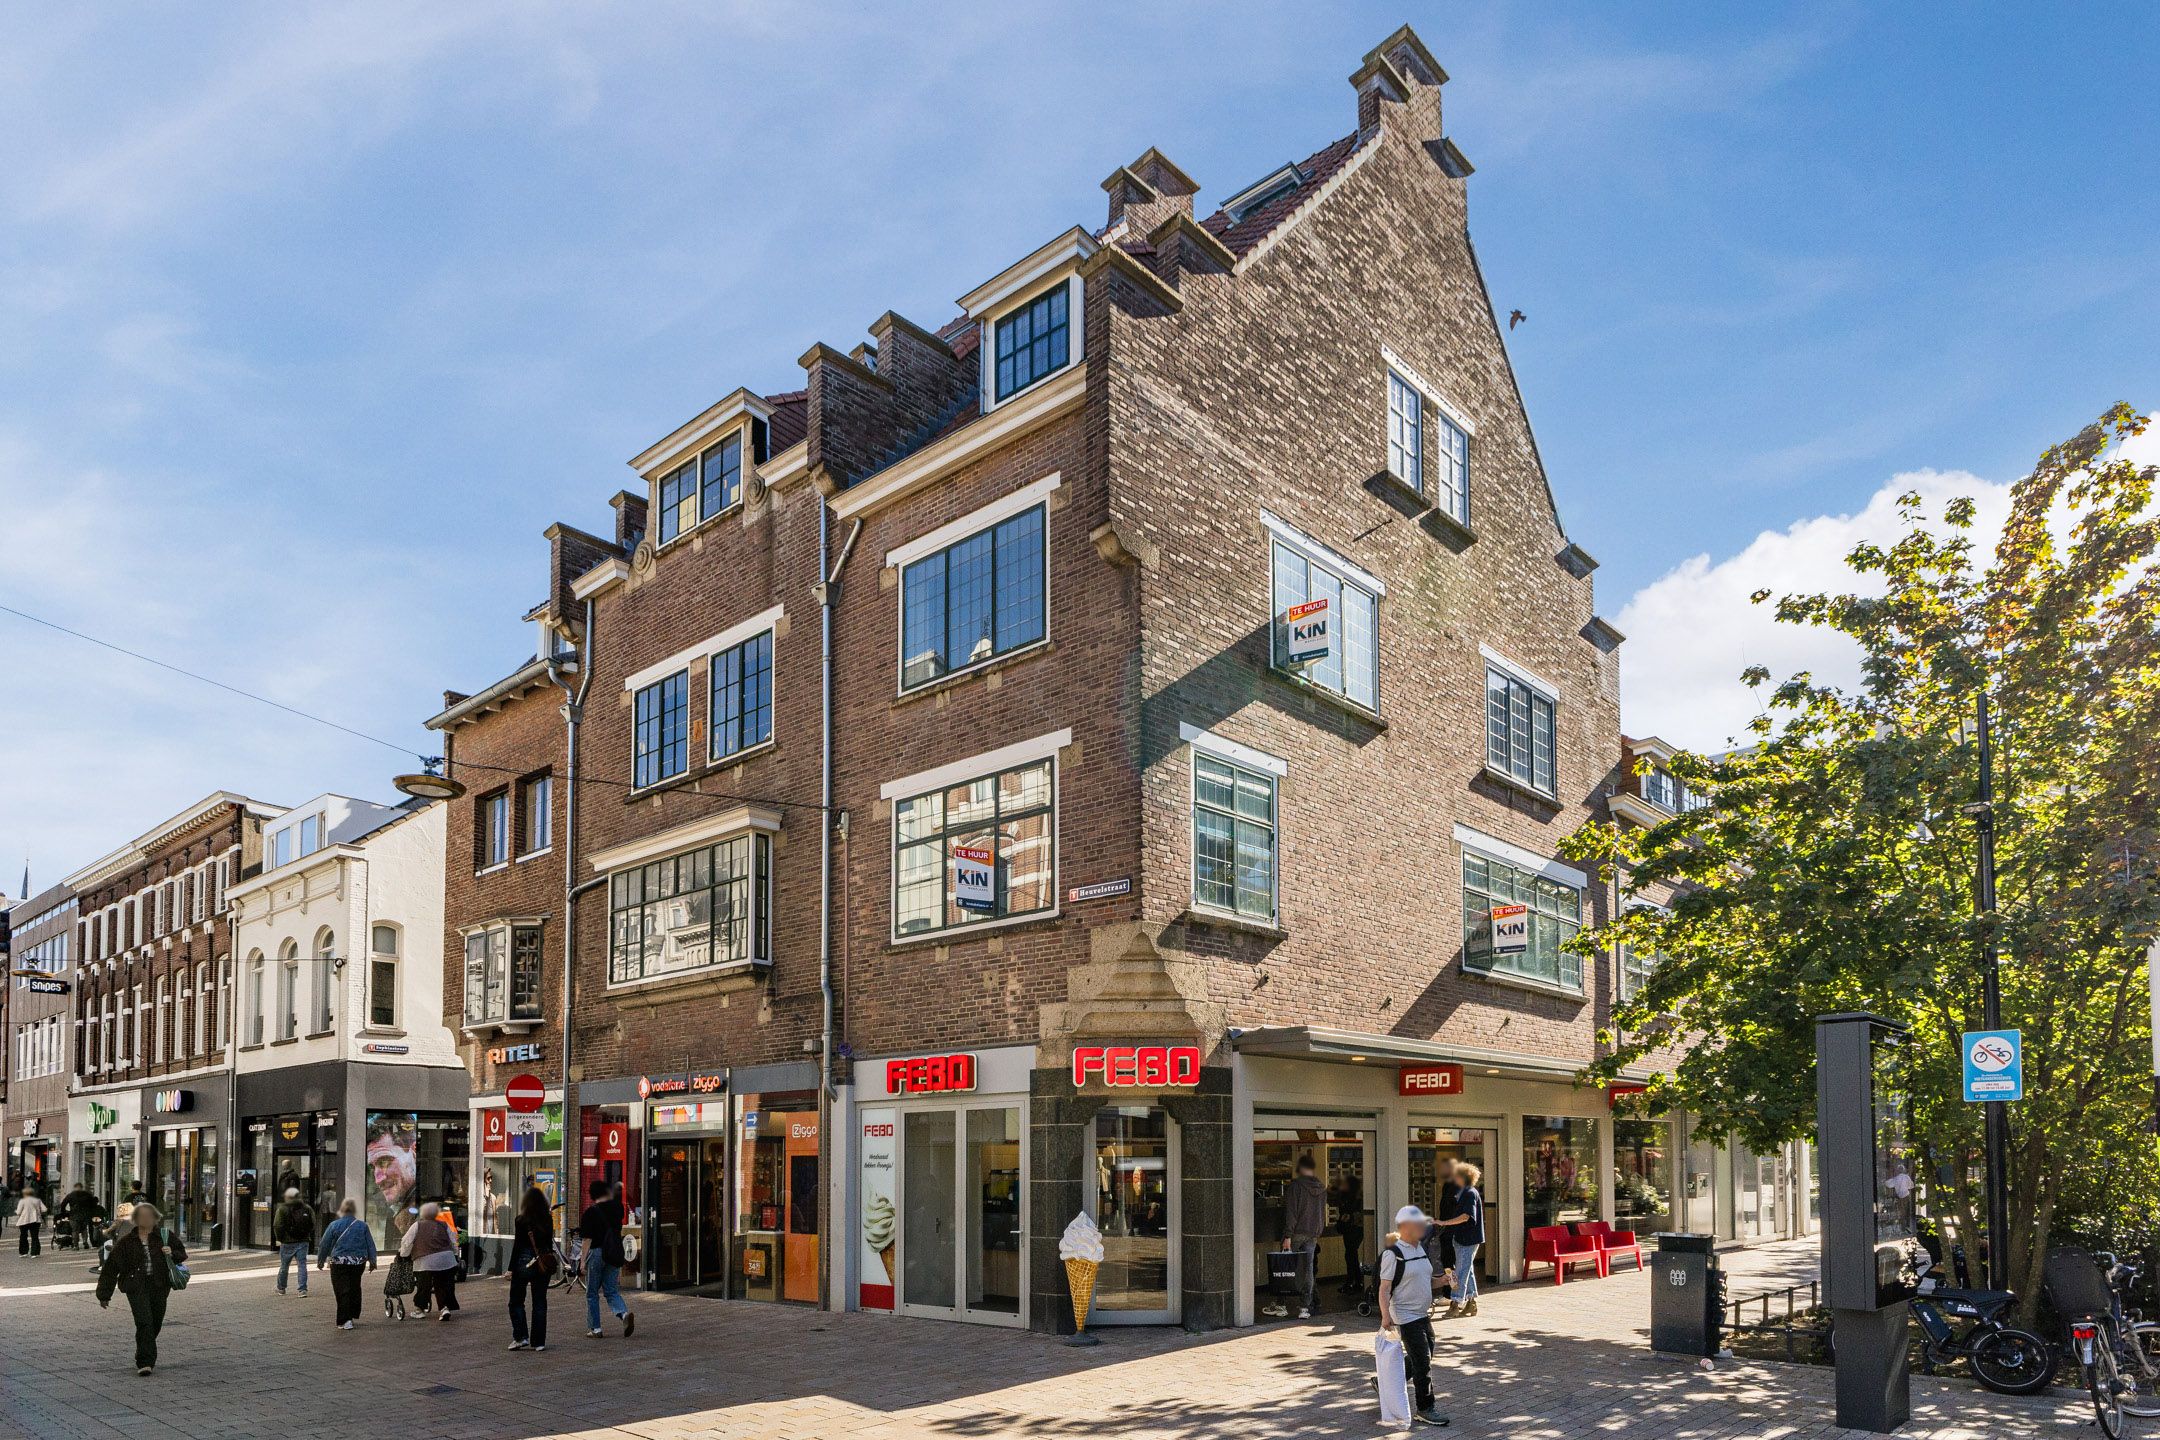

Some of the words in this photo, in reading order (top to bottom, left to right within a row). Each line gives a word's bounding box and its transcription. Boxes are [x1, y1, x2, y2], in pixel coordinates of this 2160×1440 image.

[1293, 607, 1303, 615] TE
[1304, 601, 1326, 612] HUUR
[967, 851, 989, 859] HUUR
[1079, 883, 1127, 897] Heuvelstraat
[1504, 906, 1525, 914] HUUR
[31, 981, 62, 992] snipes
[886, 1054, 974, 1094] FEBO
[1073, 1046, 1200, 1088] FEBO
[651, 1079, 686, 1092] vodafone
[693, 1074, 720, 1092] ziggo
[1405, 1072, 1451, 1090] FEBO
[95, 1106, 112, 1126] kpn
[864, 1124, 894, 1137] FEBO
